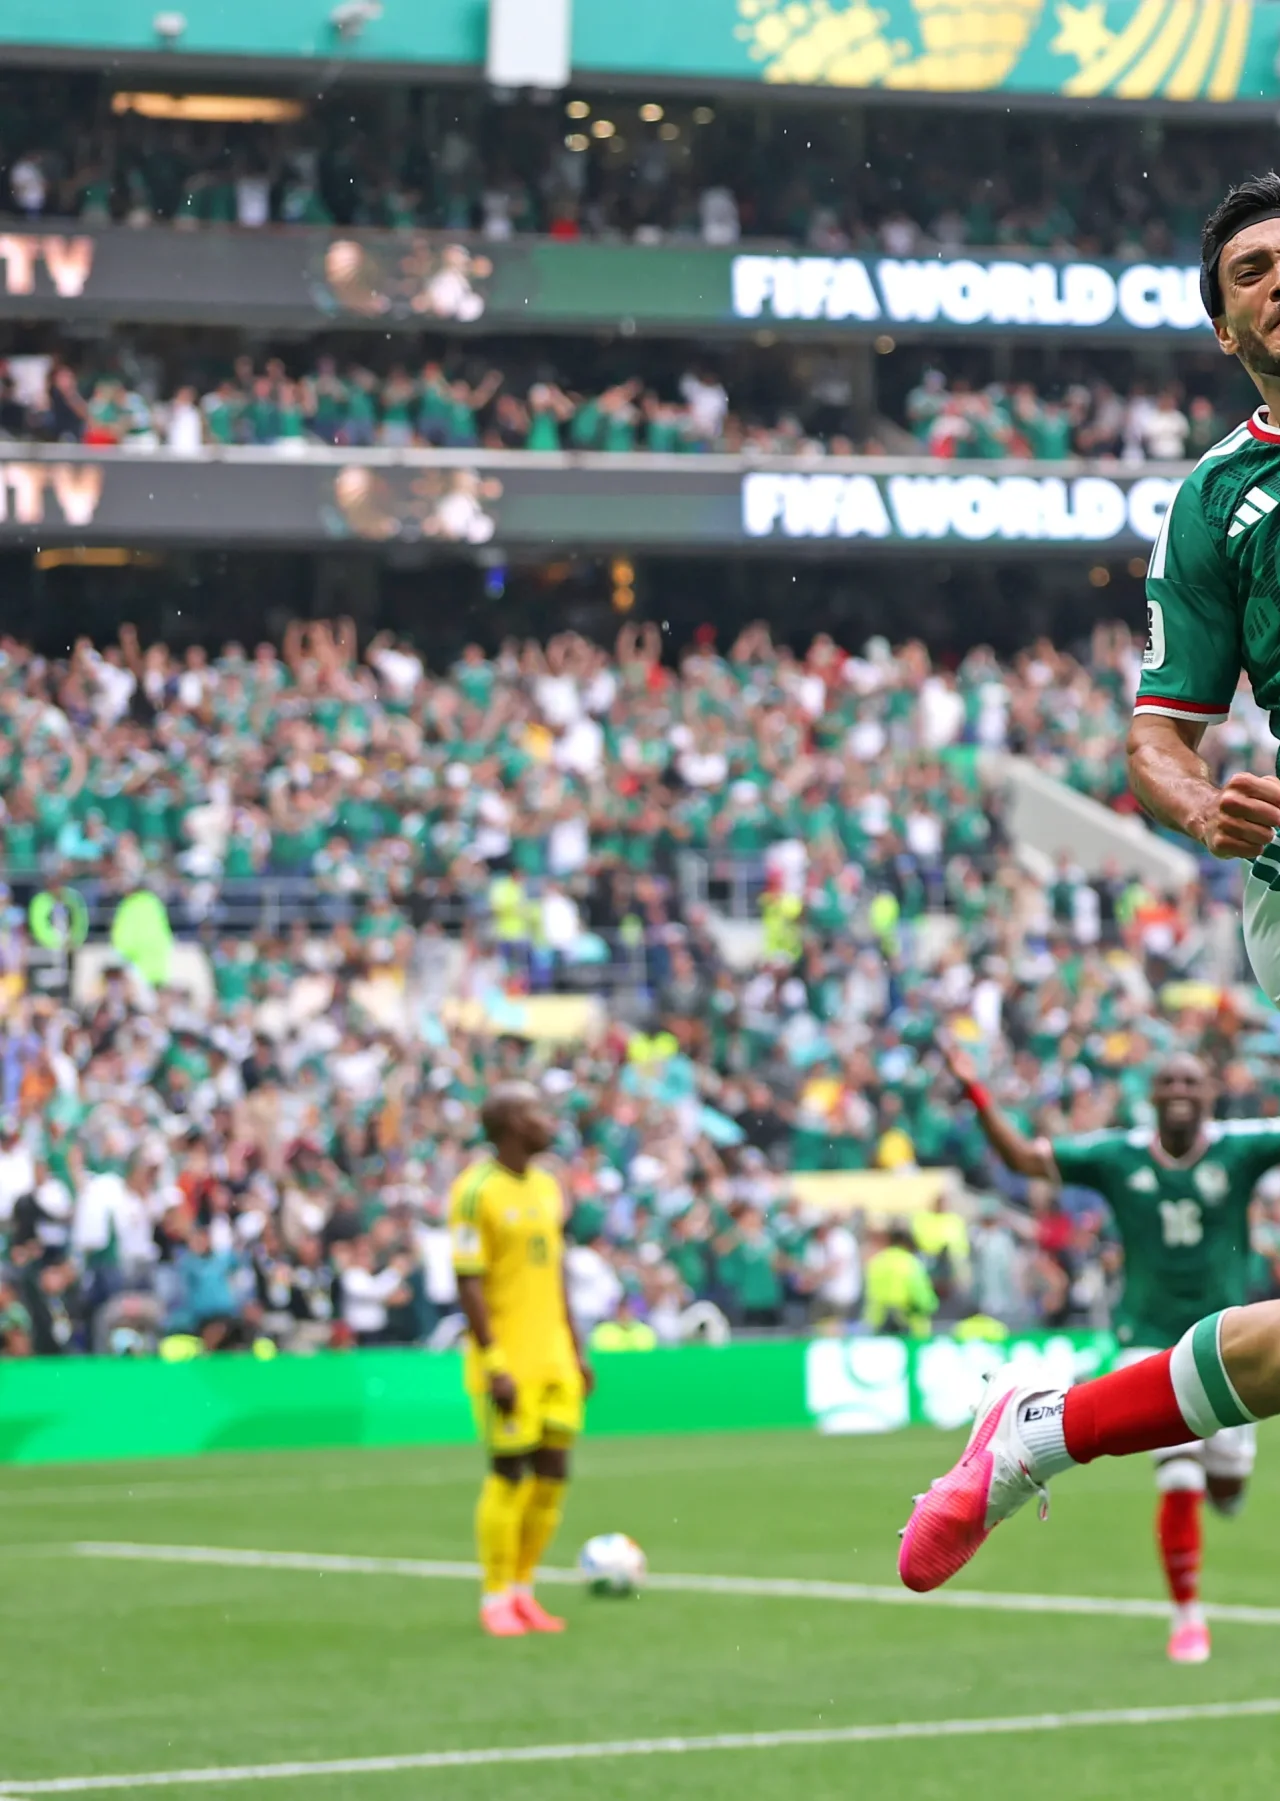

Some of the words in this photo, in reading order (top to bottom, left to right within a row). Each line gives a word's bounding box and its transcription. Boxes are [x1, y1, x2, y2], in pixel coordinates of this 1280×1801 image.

[732, 255, 880, 321] FIFA
[877, 259, 1117, 327] WORLD
[1118, 264, 1213, 330] CU
[742, 472, 893, 539] FIFA
[888, 475, 1127, 542] WORLD
